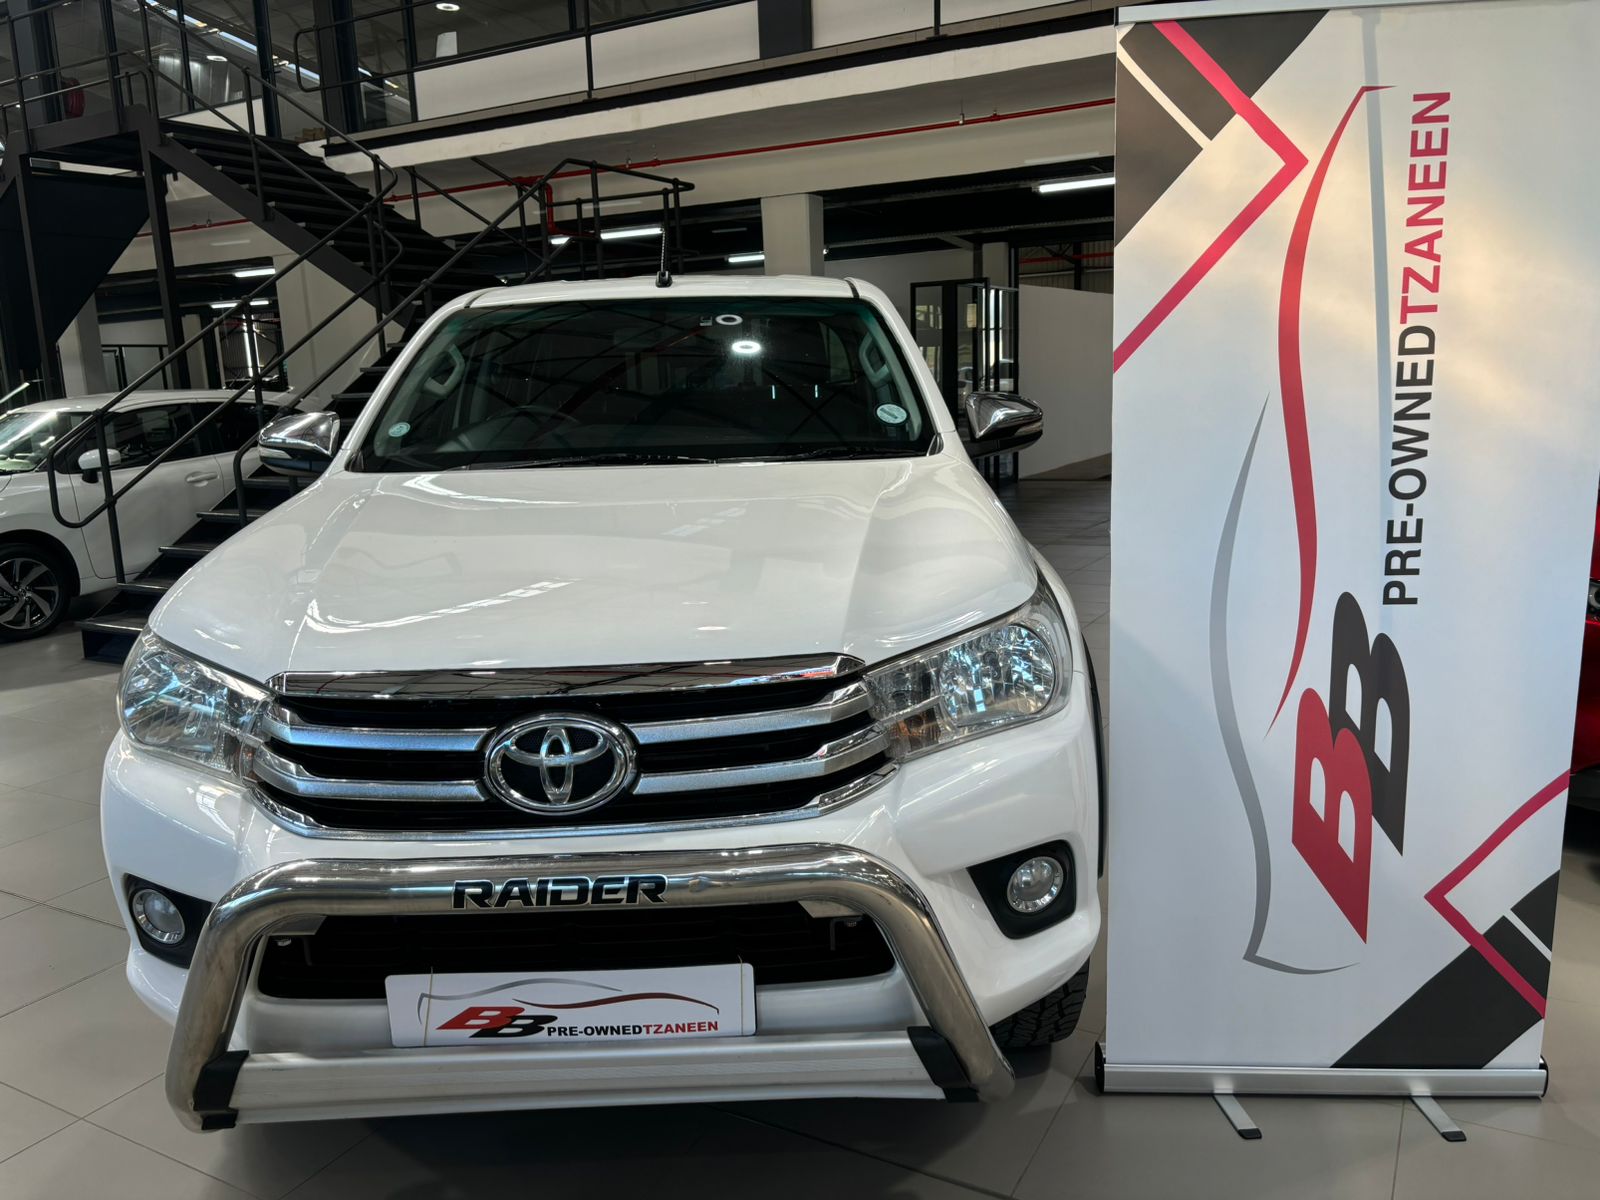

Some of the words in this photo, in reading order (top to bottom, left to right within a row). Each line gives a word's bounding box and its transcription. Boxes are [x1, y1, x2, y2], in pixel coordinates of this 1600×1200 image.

[1292, 591, 1410, 944] BB
[452, 874, 669, 909] RAIDER
[435, 1006, 558, 1038] BB
